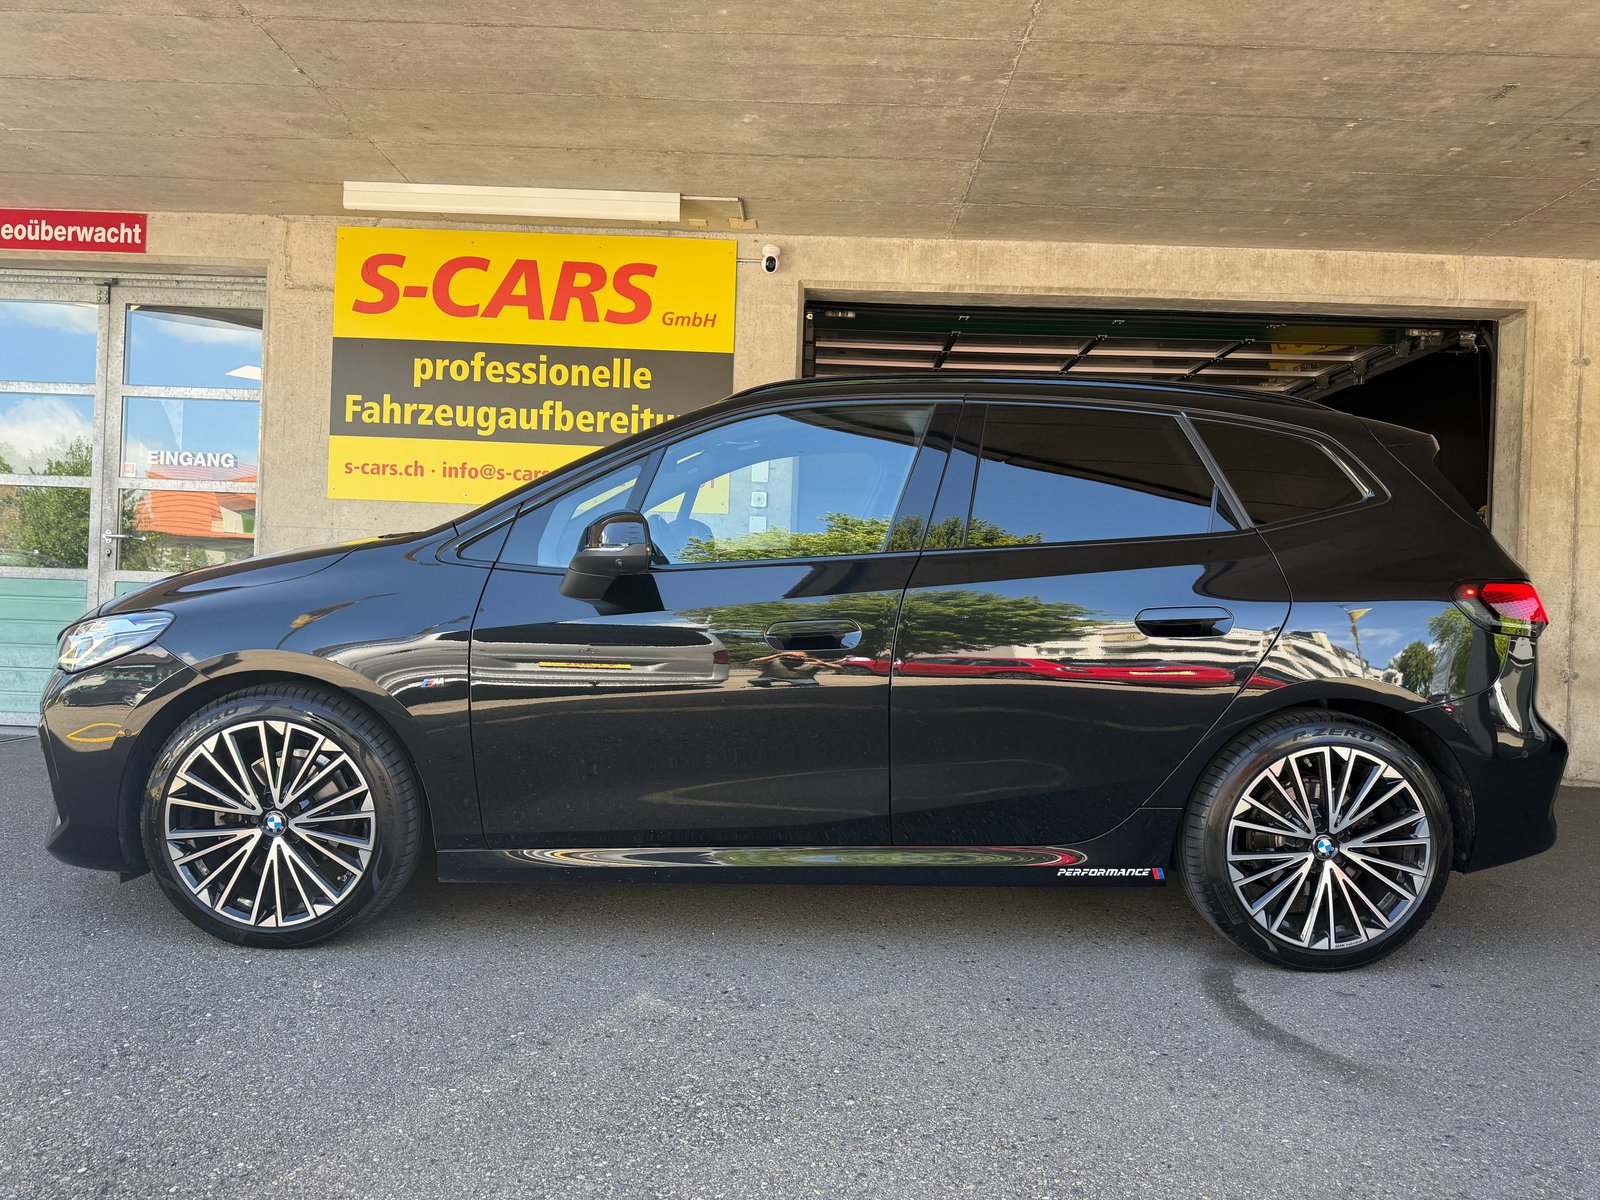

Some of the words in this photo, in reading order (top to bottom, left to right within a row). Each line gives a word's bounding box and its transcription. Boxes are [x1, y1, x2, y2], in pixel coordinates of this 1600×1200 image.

[0, 219, 142, 244] eoüberwacht
[351, 253, 658, 325] S-CARS
[661, 311, 717, 328] GmbH
[412, 351, 652, 390] professionelle
[344, 394, 681, 436] Fahrzeugaufbereit
[147, 450, 236, 468] EINGANG
[344, 460, 424, 477] s-cars.ch
[1312, 727, 1377, 743] ZERO
[1057, 867, 1151, 877] PERFORMANCE
